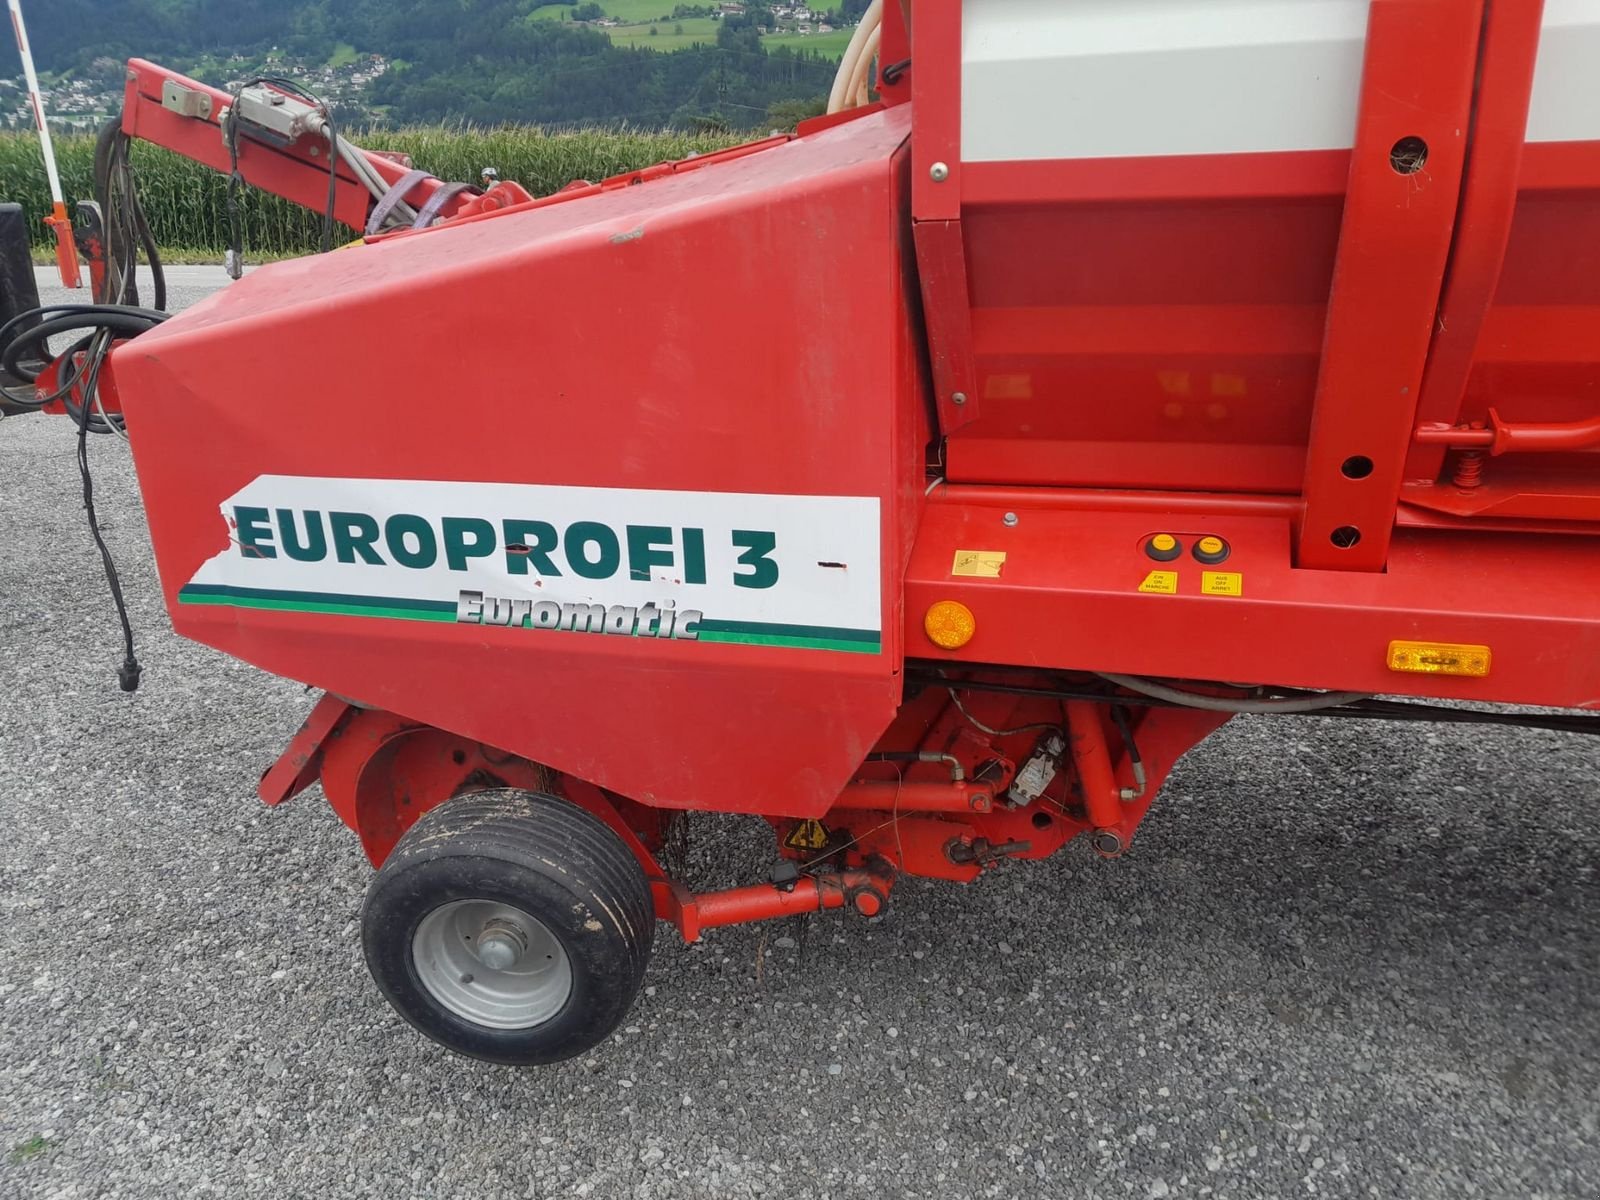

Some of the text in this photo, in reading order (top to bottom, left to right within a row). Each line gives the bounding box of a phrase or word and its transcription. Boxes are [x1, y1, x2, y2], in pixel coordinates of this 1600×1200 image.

[233, 505, 780, 590] EUROPROFI 3
[456, 589, 704, 640] Euromatic
